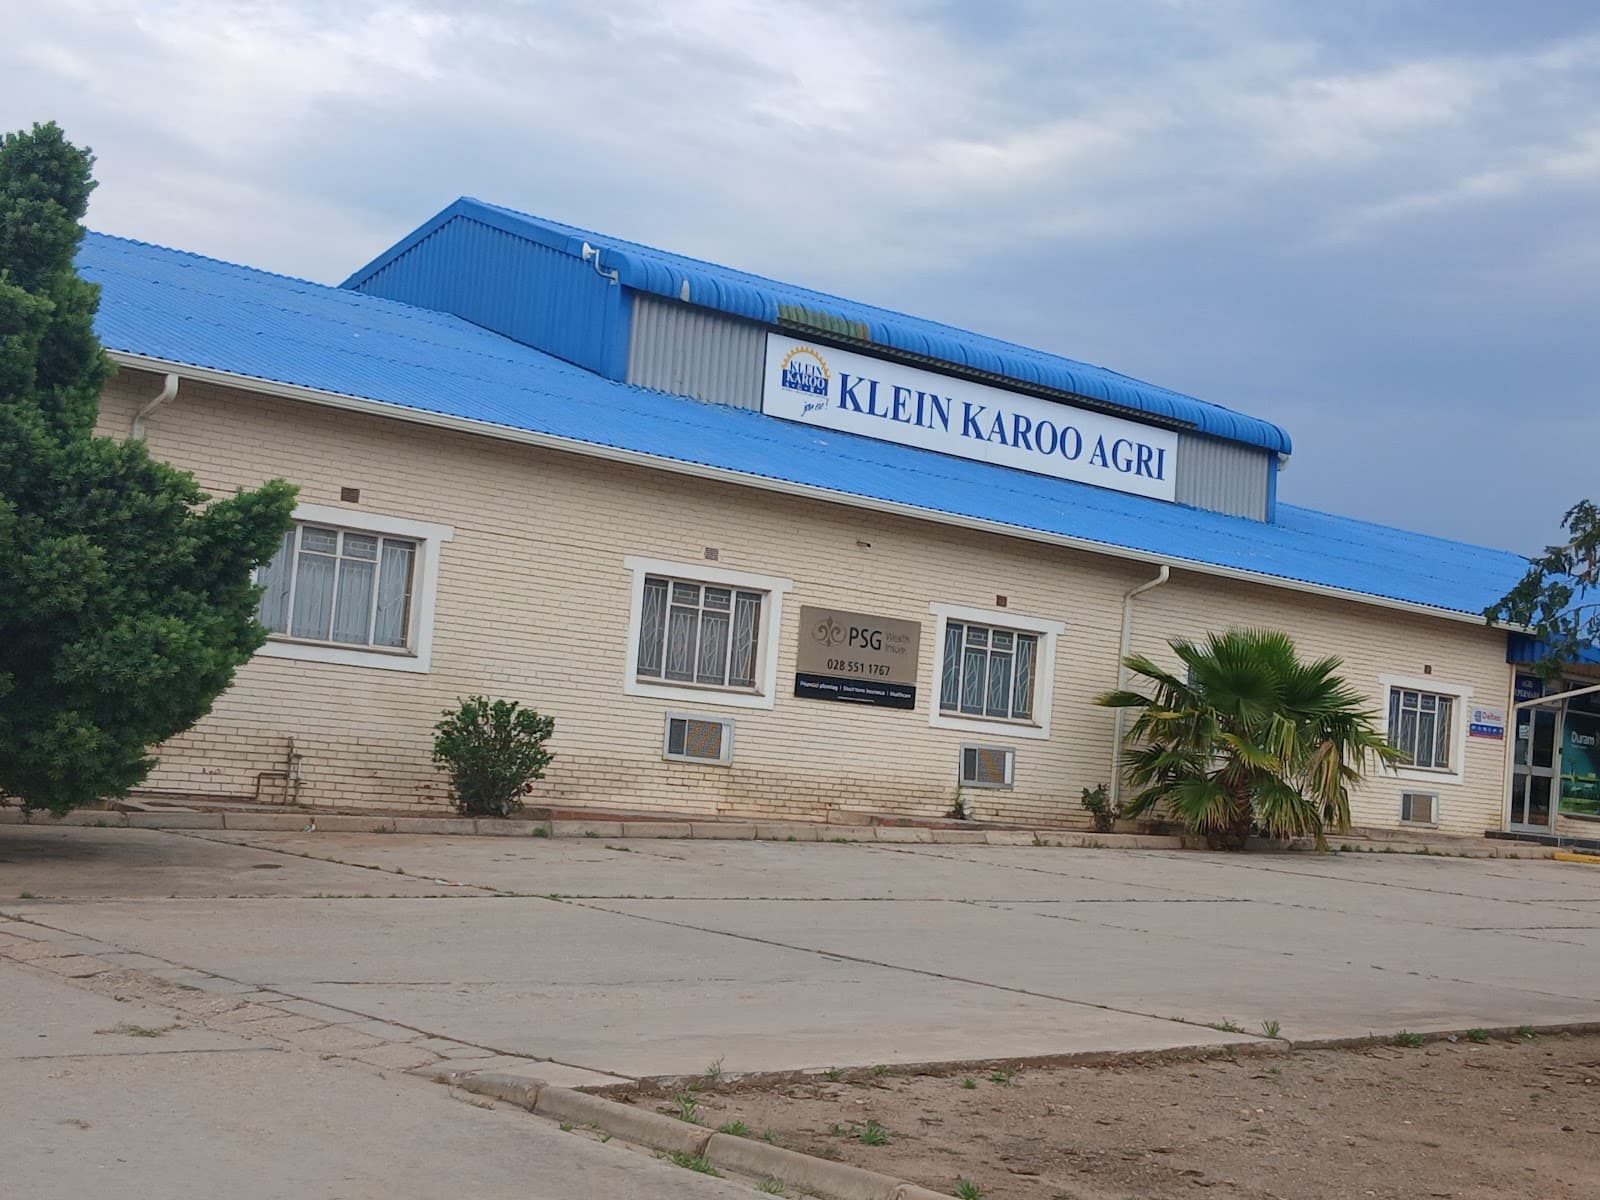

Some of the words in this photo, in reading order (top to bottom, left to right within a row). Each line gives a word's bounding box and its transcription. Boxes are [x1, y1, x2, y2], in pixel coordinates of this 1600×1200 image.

[790, 360, 823, 376] KLEIN
[787, 370, 825, 389] KAROO
[838, 372, 953, 433] KLEIN
[961, 402, 1083, 461] KAROO
[1089, 434, 1167, 481] AGRI
[848, 627, 882, 650] PSG
[827, 658, 845, 671] 028
[847, 661, 864, 672] 551
[868, 663, 890, 676] 1767
[1571, 730, 1595, 745] Duram
